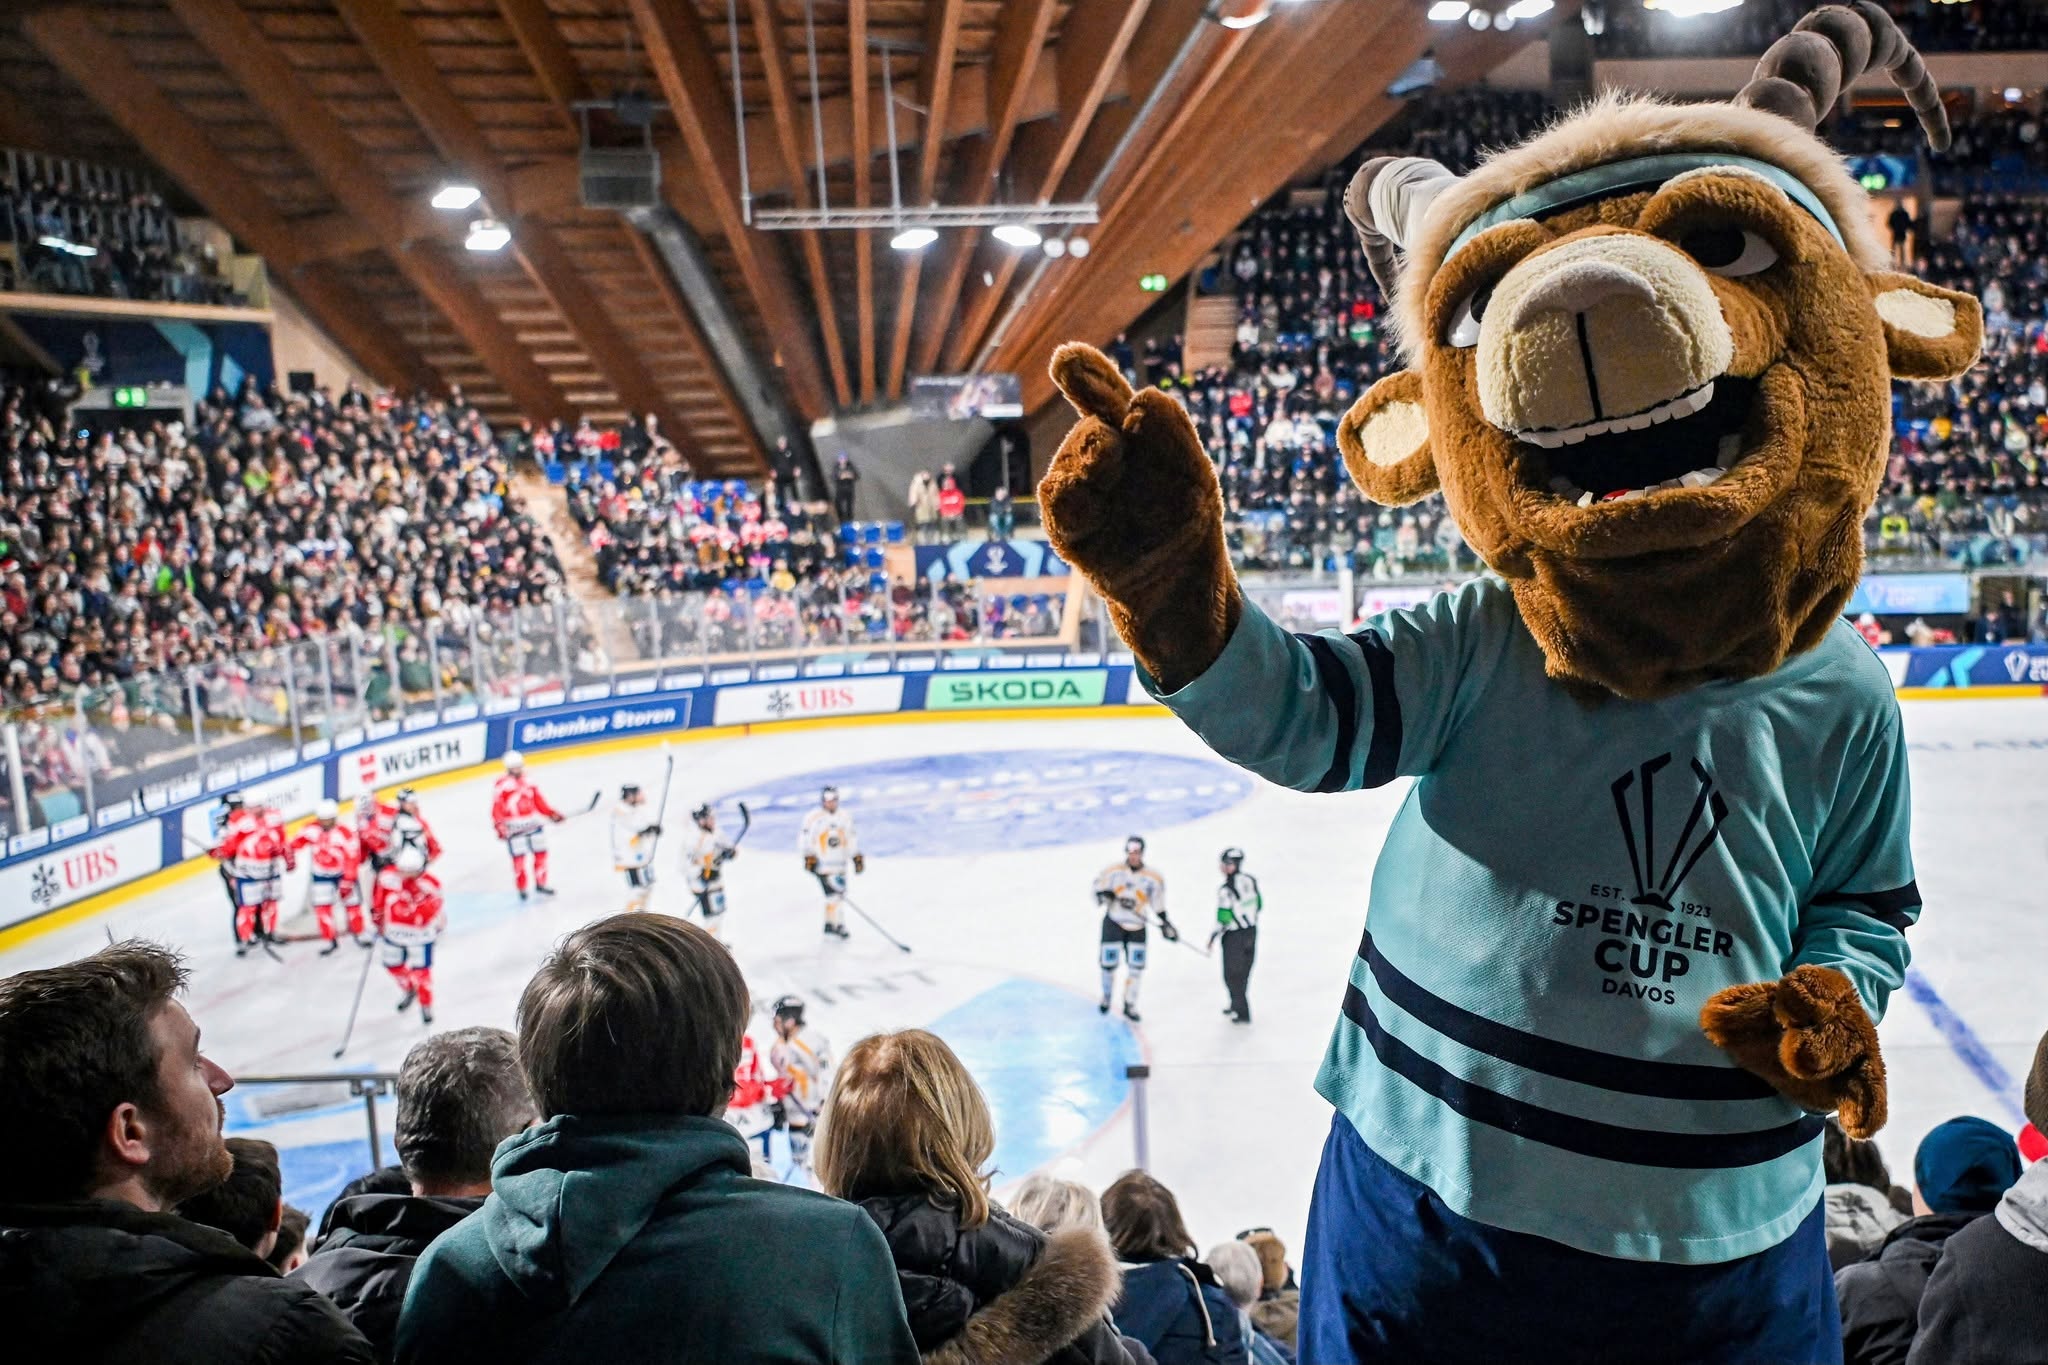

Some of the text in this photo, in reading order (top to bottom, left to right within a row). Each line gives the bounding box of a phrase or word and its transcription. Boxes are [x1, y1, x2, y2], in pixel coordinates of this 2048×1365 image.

[799, 687, 854, 711] UBS
[521, 707, 676, 743] Schenker Storen
[63, 843, 119, 890] UBS
[1590, 883, 1625, 901] EST.
[1680, 901, 1712, 919] 1923
[1552, 900, 1734, 958] SPENGLER
[1594, 938, 1690, 983] CUP
[1602, 978, 1676, 1005] DAVOS
